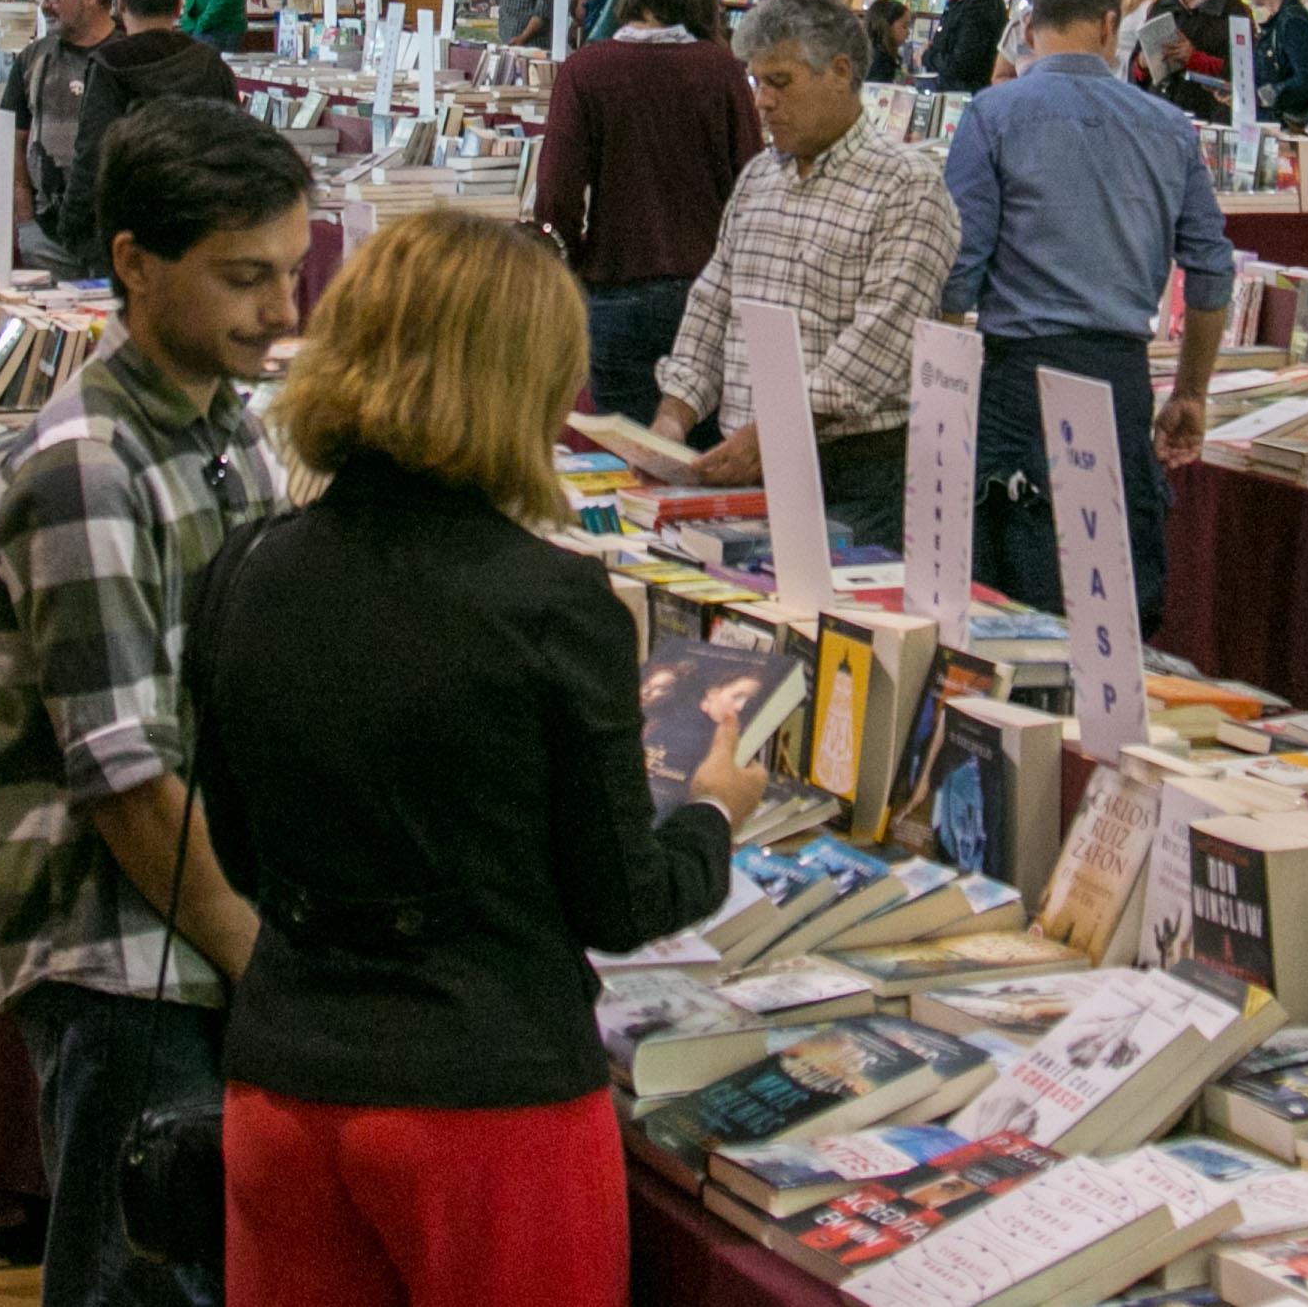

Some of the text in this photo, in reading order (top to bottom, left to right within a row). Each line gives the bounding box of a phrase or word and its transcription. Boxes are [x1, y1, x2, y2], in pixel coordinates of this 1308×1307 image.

[935, 369, 969, 394] Planeta
[933, 422, 944, 605] PLANETA
[1081, 507, 1117, 714] VASP
[1092, 791, 1152, 831] CARLOS
[1092, 816, 1131, 851] RUIZ
[1206, 854, 1238, 896] DON
[1193, 884, 1263, 939] WINSLOW
[1021, 1070, 1085, 1114] CARRASCO
[1030, 1051, 1101, 1100] DANIEL COLE
[815, 1211, 845, 1228] EM
[840, 1194, 931, 1242] ACREDITA
